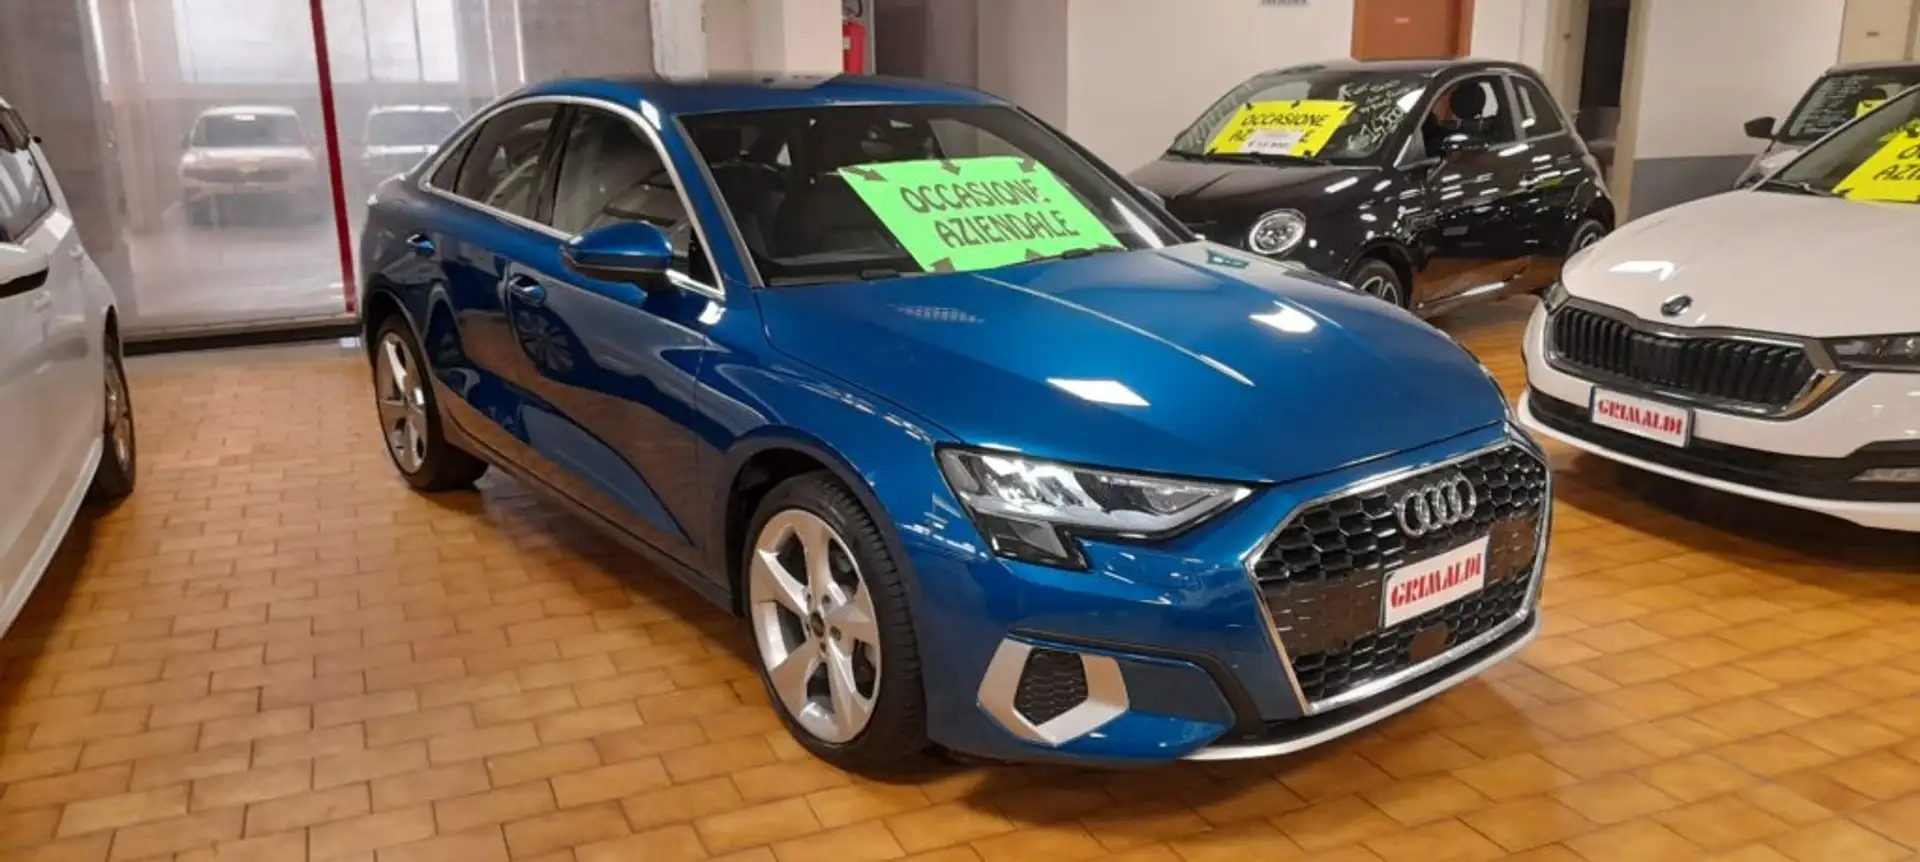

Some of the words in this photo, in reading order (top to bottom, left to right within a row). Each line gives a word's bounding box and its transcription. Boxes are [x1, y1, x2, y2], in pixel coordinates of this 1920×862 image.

[1241, 113, 1329, 127] OCCASIONE
[900, 178, 1050, 214] OCCASIONE
[934, 210, 1080, 249] AZIENDALE
[1598, 400, 1683, 434] GRIMALDI
[1391, 553, 1482, 608] GRIMALDI
